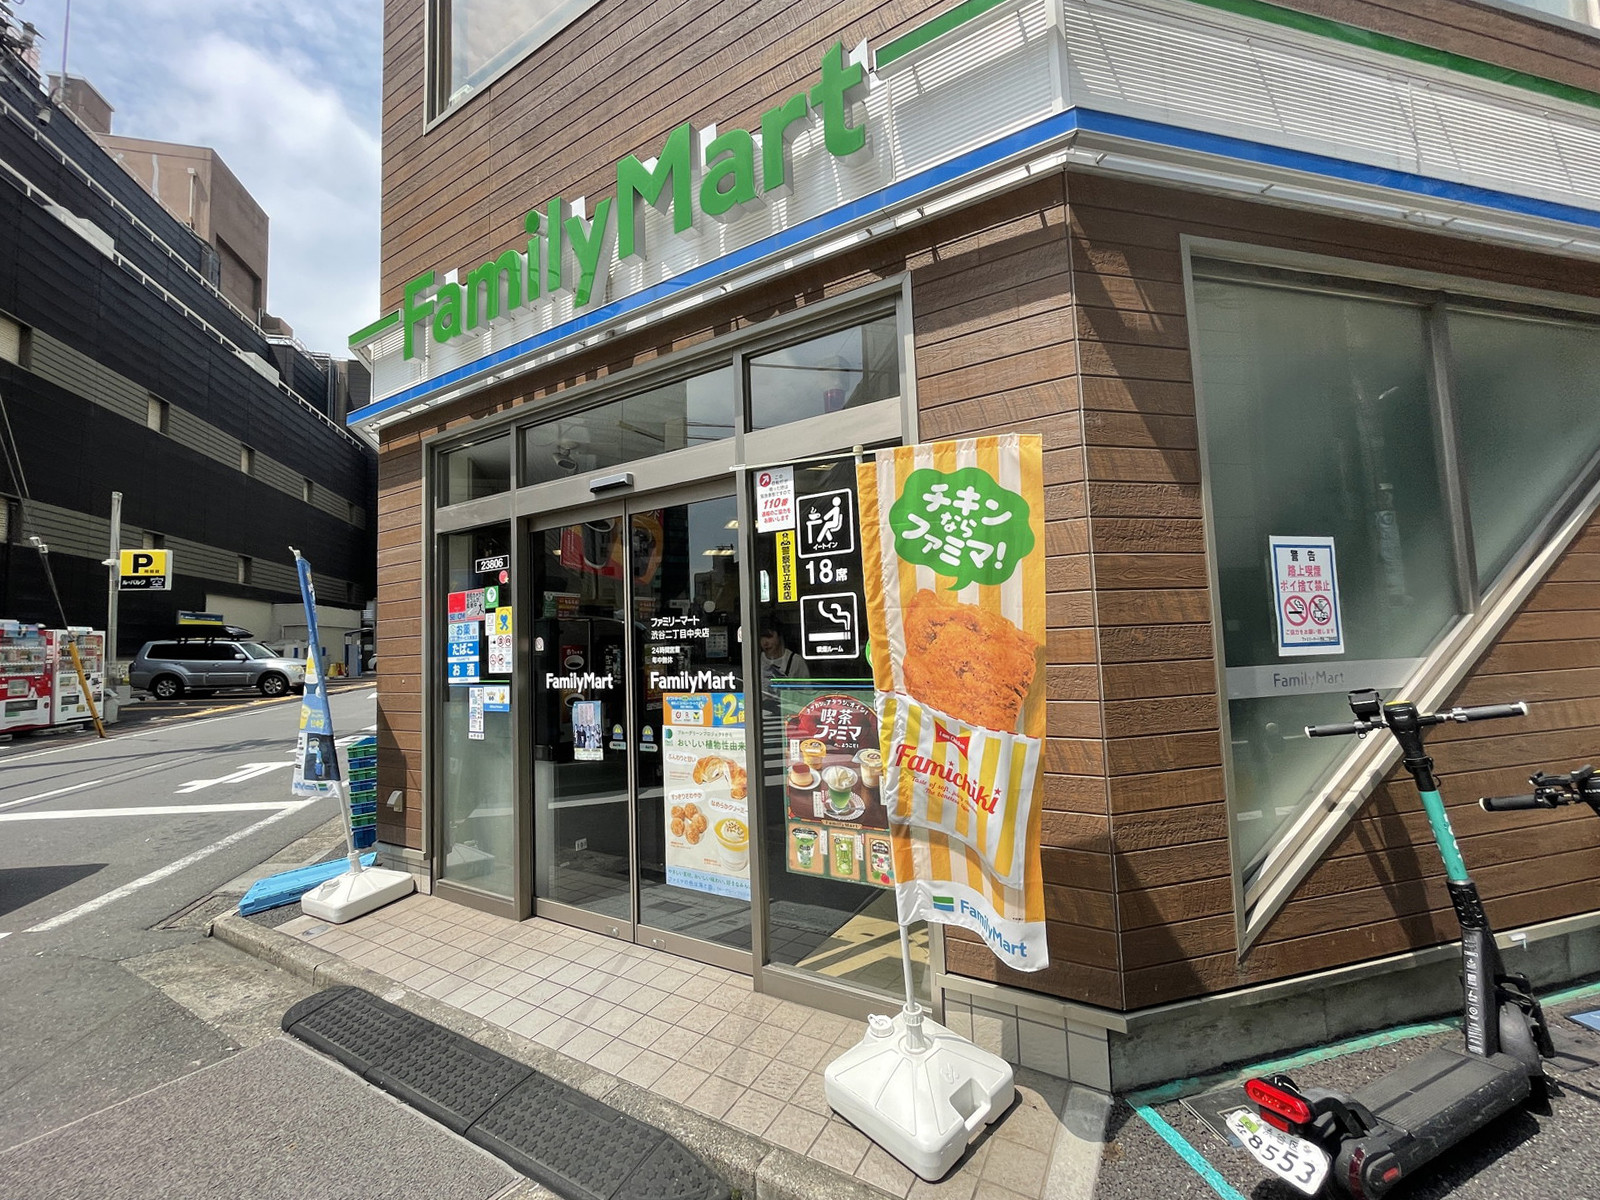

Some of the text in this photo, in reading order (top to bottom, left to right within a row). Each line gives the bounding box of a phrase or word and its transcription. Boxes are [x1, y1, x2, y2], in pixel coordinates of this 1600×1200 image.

[404, 40, 867, 360] FamilyMart
[764, 498, 788, 509] 110番
[922, 484, 1013, 526] チキン
[940, 512, 977, 538] なら
[813, 542, 838, 550] イートイン
[901, 513, 1007, 570] ファミマ!
[1290, 549, 1315, 562] 警告
[132, 554, 153, 573] P
[481, 558, 503, 570] 23806
[1287, 564, 1321, 577] 路上喫煙
[651, 615, 700, 627] ファミリーマート
[456, 623, 471, 636] お薬
[651, 628, 710, 640] 渋谷二丁目中央店
[452, 643, 475, 656] たばこ
[651, 646, 681, 654] 24時間営業
[453, 663, 476, 677] お酒
[546, 672, 613, 693] FamilyMart
[650, 670, 736, 693] FamilyMart
[1273, 671, 1344, 688] FamilyMart
[820, 709, 853, 725] 喫茶
[813, 725, 862, 741] ファミマ
[895, 744, 1001, 814] Famichiki
[912, 776, 927, 785] Taste
[924, 787, 935, 796] The
[960, 899, 1028, 958] FamilyMart
[1248, 1134, 1316, 1184] 8553
